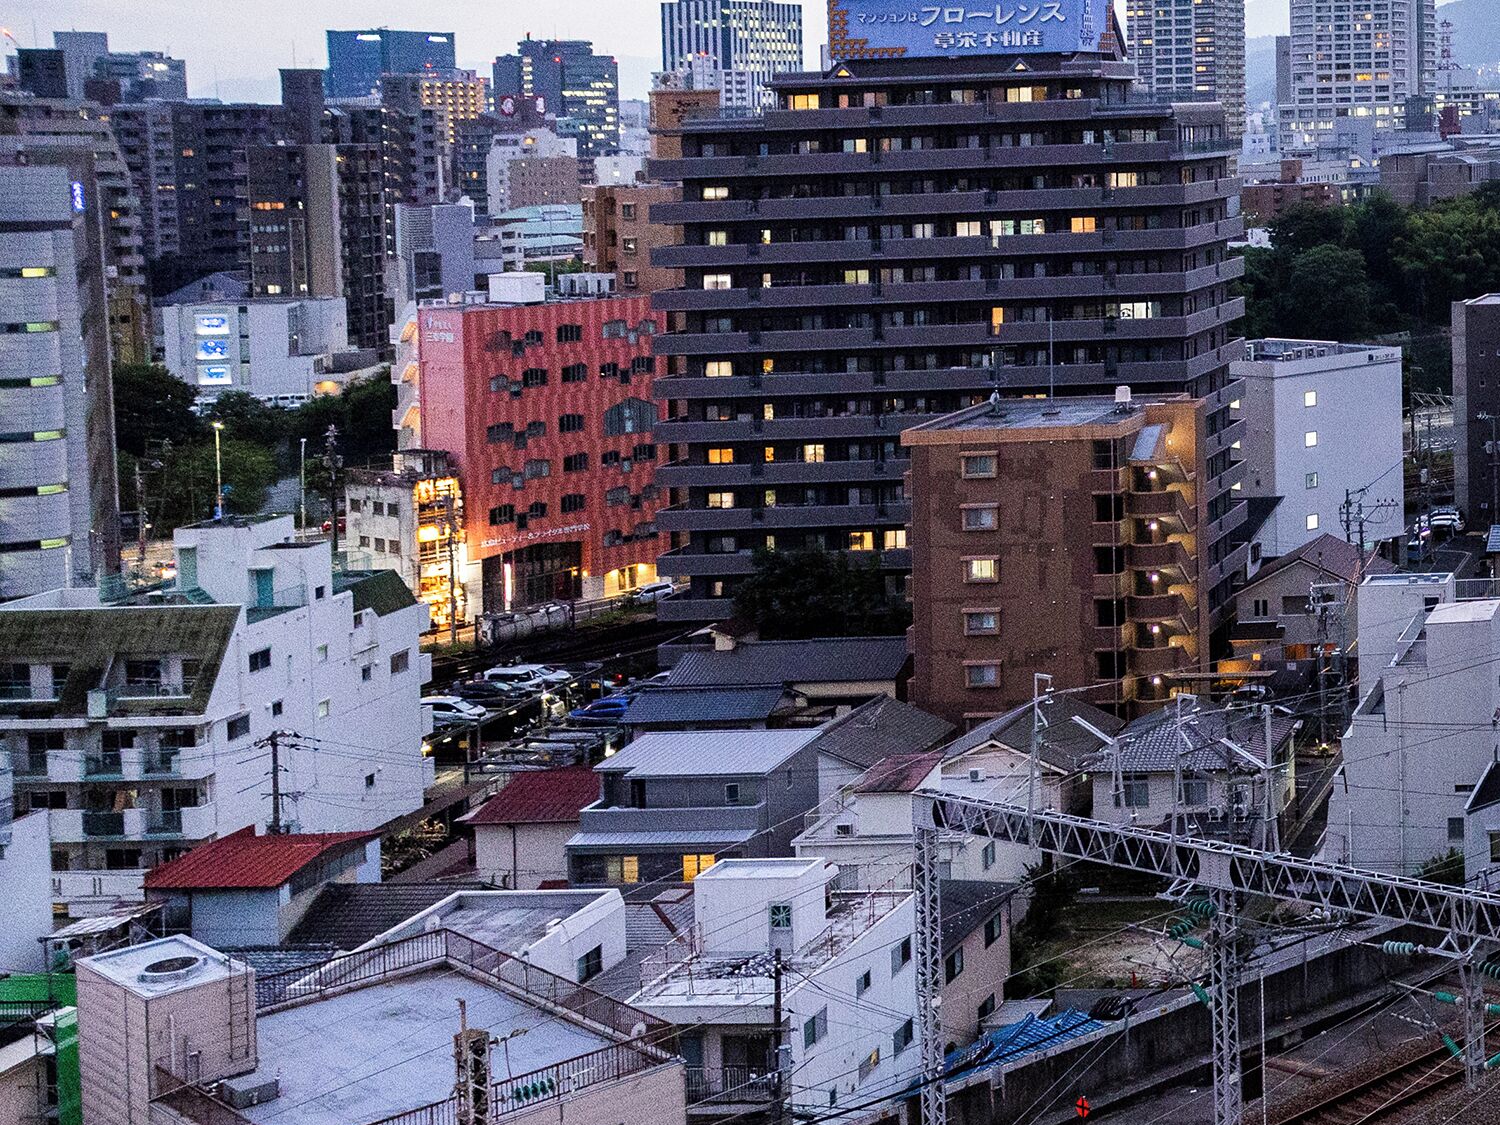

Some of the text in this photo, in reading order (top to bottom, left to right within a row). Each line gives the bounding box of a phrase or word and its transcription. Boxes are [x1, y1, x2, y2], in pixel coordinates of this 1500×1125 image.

[933, 30, 1042, 48] 章栄不動産
